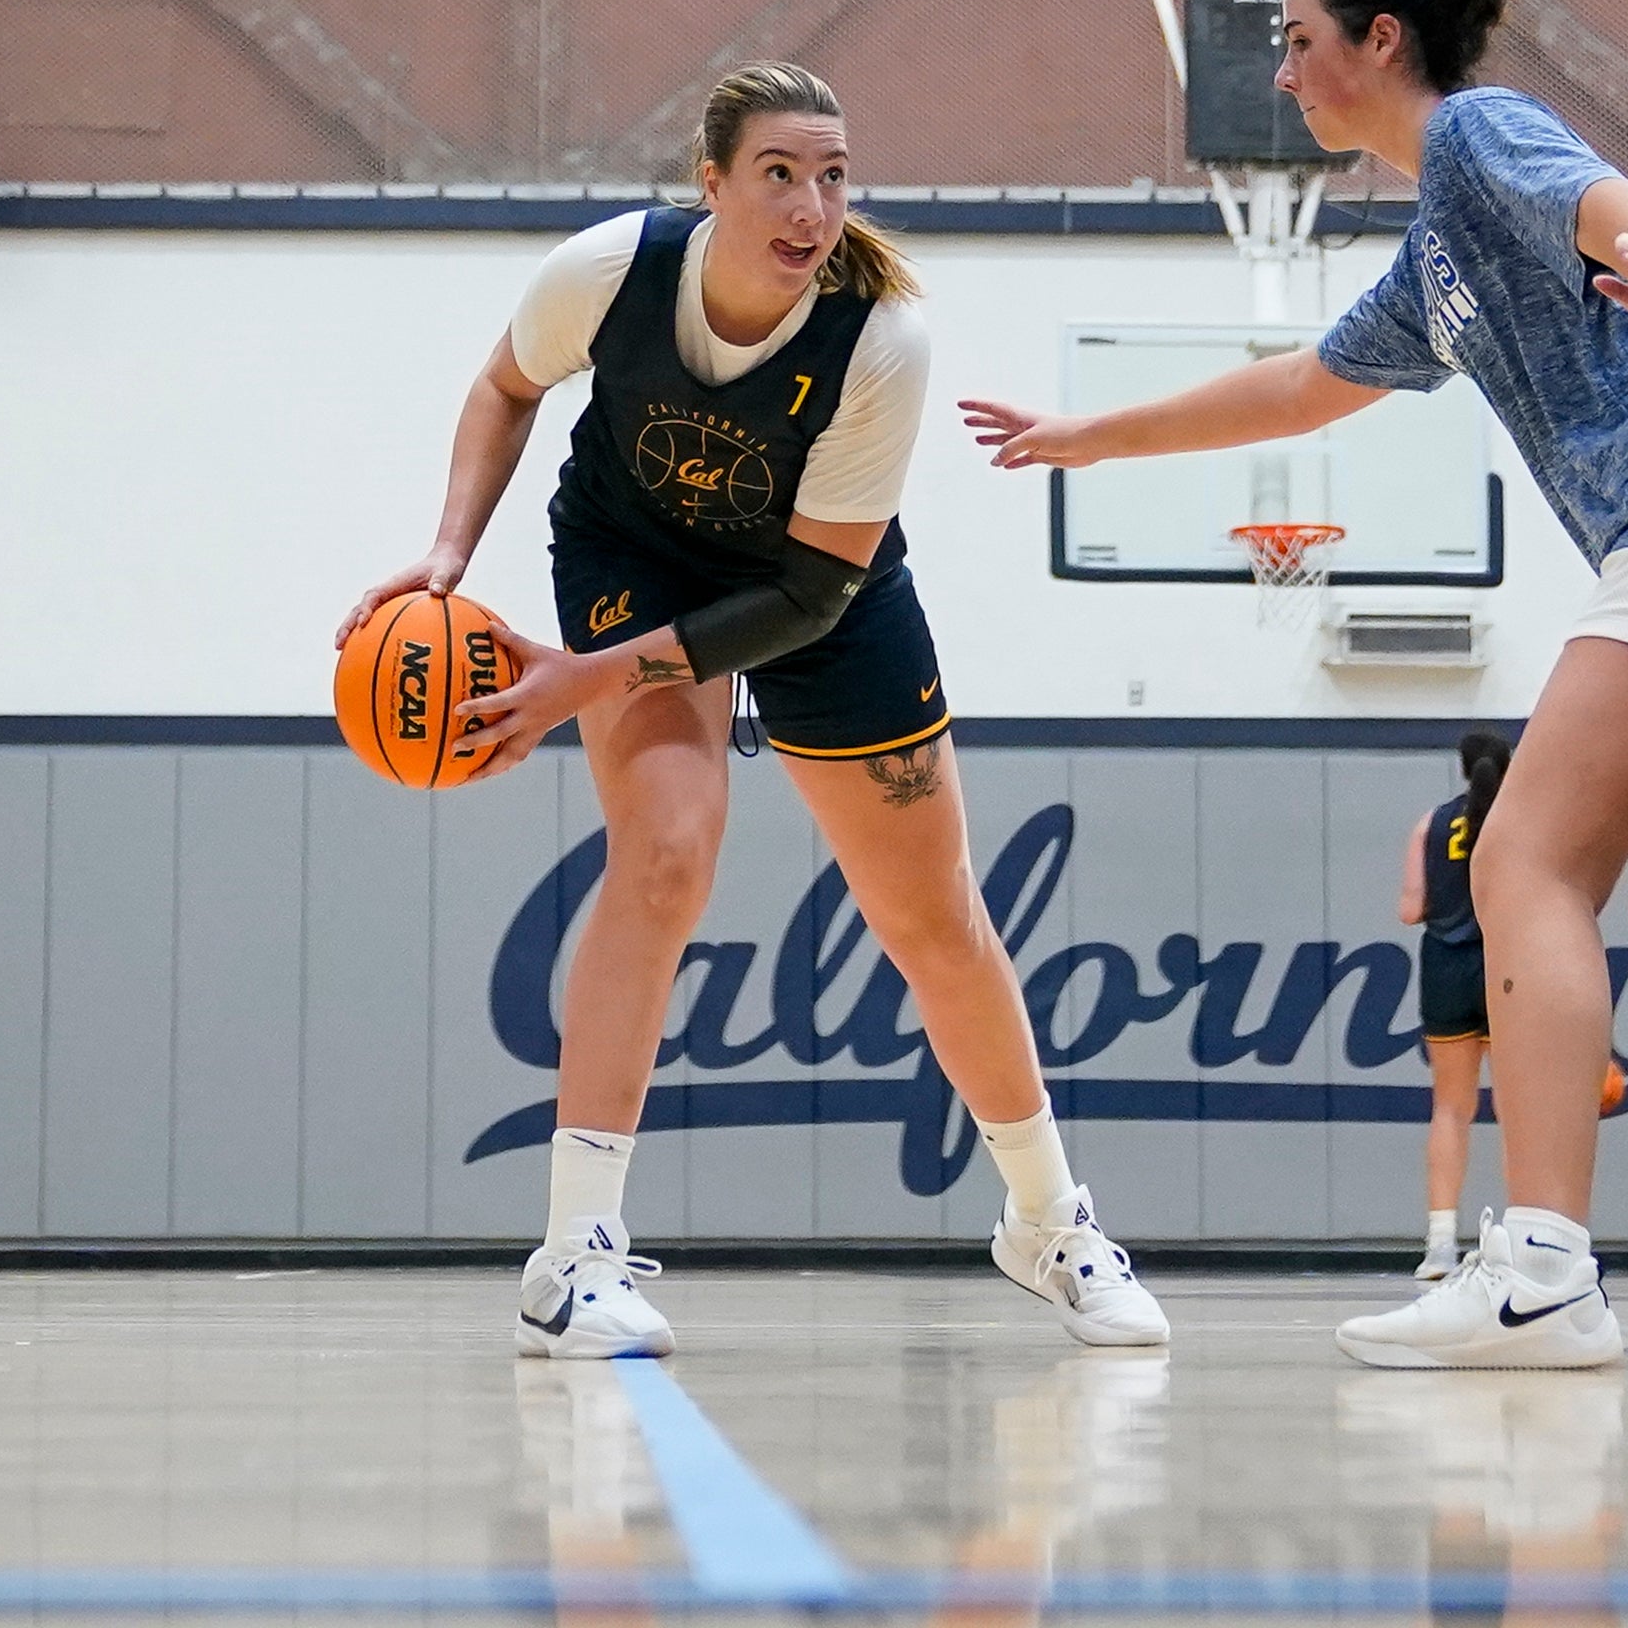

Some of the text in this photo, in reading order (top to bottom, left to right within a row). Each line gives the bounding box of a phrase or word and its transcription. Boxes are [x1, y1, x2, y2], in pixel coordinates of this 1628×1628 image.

[787, 374, 813, 416] 7
[647, 402, 768, 453] CALIFORNIA
[676, 459, 724, 491] Cal
[587, 589, 634, 638] Cal
[399, 640, 432, 740] NCAA
